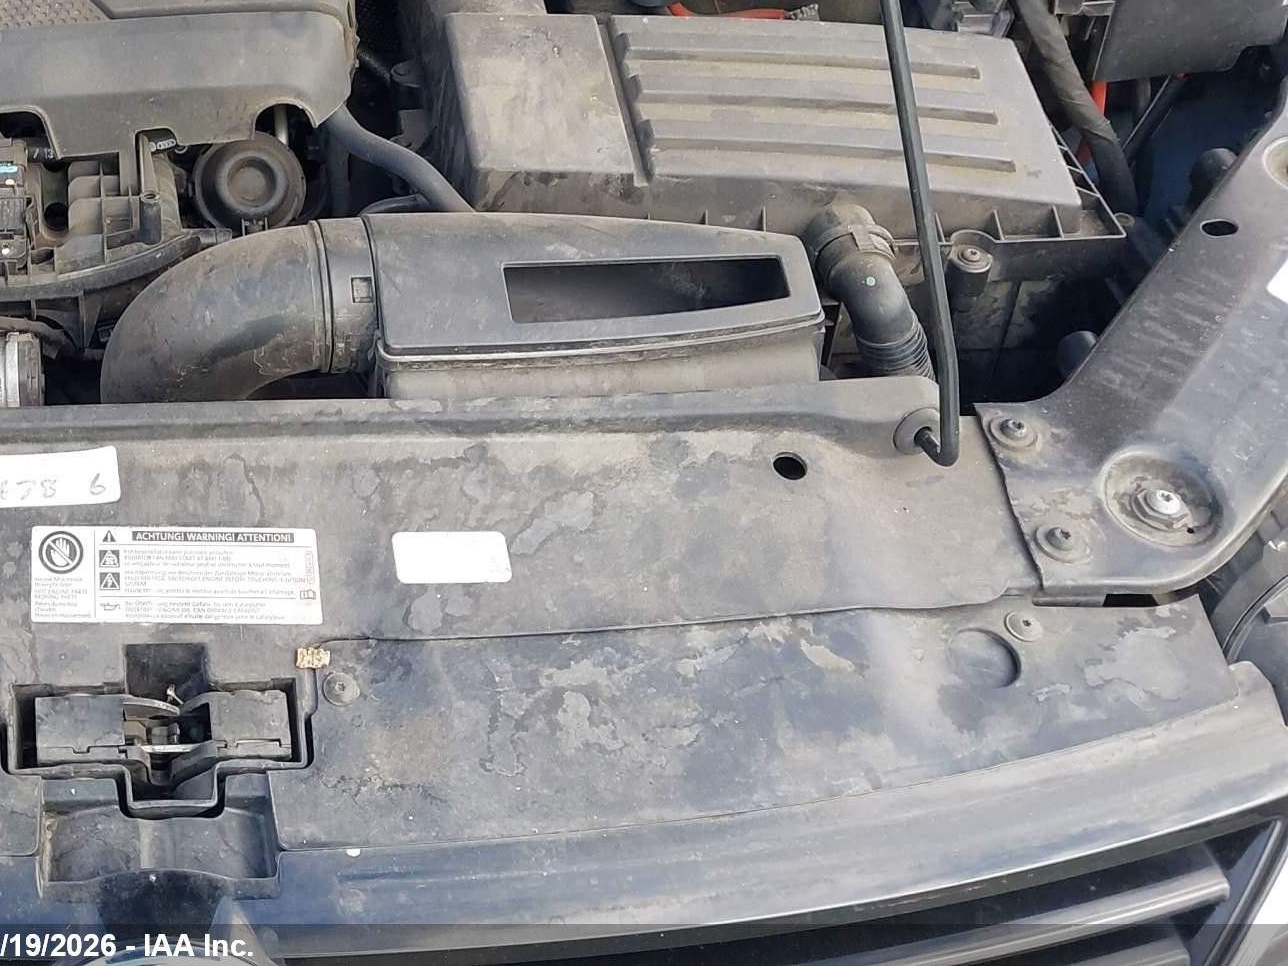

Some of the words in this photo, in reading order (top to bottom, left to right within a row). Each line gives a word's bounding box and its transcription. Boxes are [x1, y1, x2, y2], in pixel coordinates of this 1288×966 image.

[135, 532, 185, 541] ACHTUNG!
[186, 532, 236, 542] WARNING!
[237, 533, 292, 543] ATTENTION!
